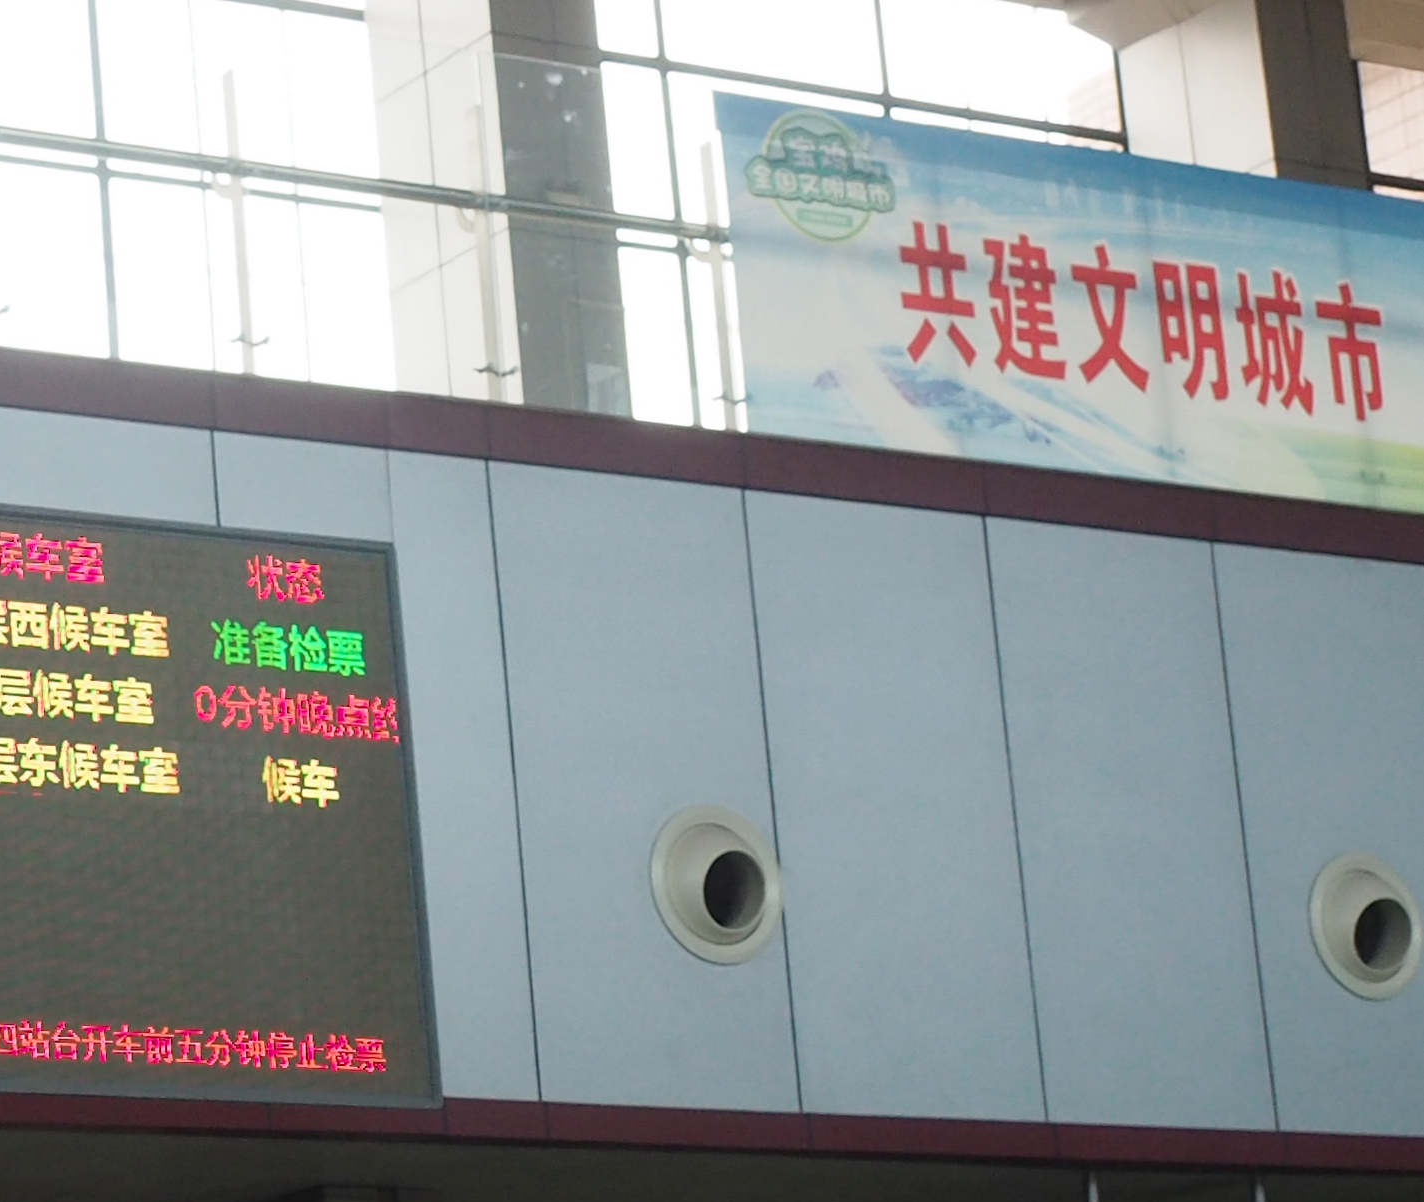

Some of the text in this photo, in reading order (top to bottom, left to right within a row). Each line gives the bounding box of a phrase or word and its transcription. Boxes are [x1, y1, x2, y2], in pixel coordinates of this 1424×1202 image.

[899, 220, 1384, 421] 共建文明城市
[247, 555, 325, 604] 状态
[210, 619, 367, 677] 准备检票
[262, 755, 340, 808] 候车
